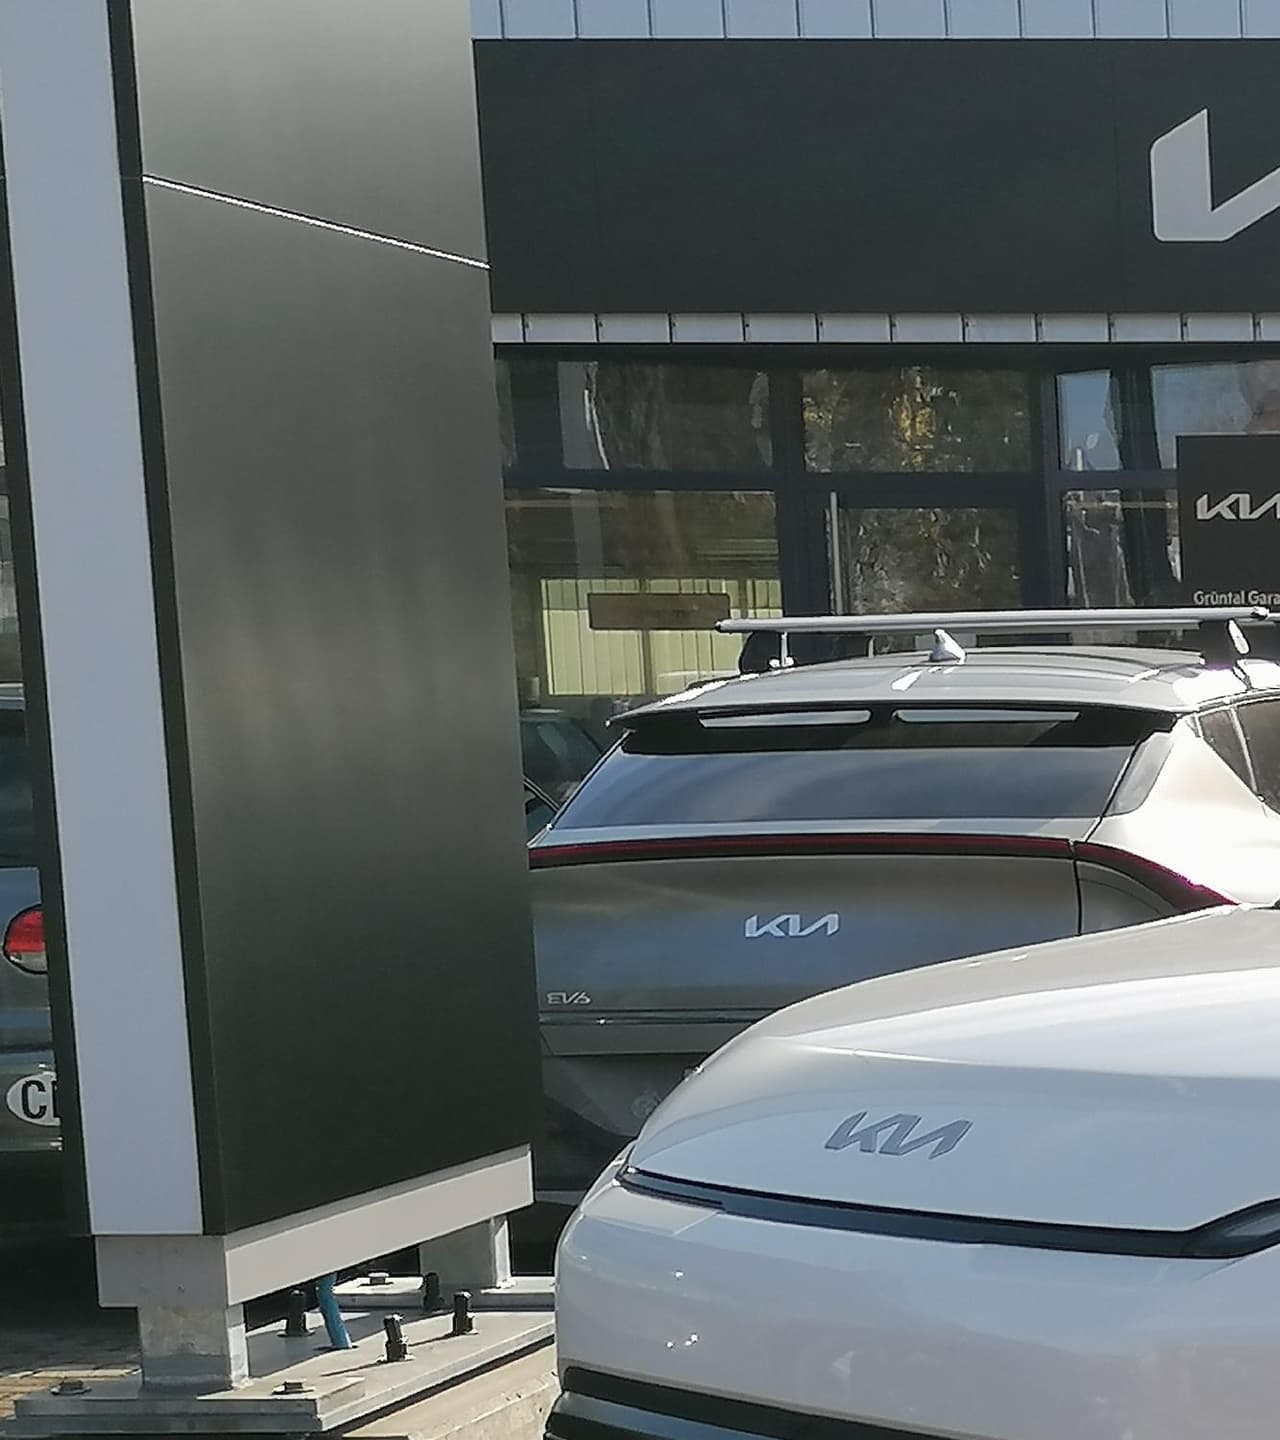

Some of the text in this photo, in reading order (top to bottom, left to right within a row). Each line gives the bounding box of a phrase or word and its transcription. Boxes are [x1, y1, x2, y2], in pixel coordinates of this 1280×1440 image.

[1193, 589, 1246, 606] Grüntal
[744, 912, 840, 938] KIA
[546, 990, 592, 1005] EV6
[824, 1111, 974, 1160] KIA
